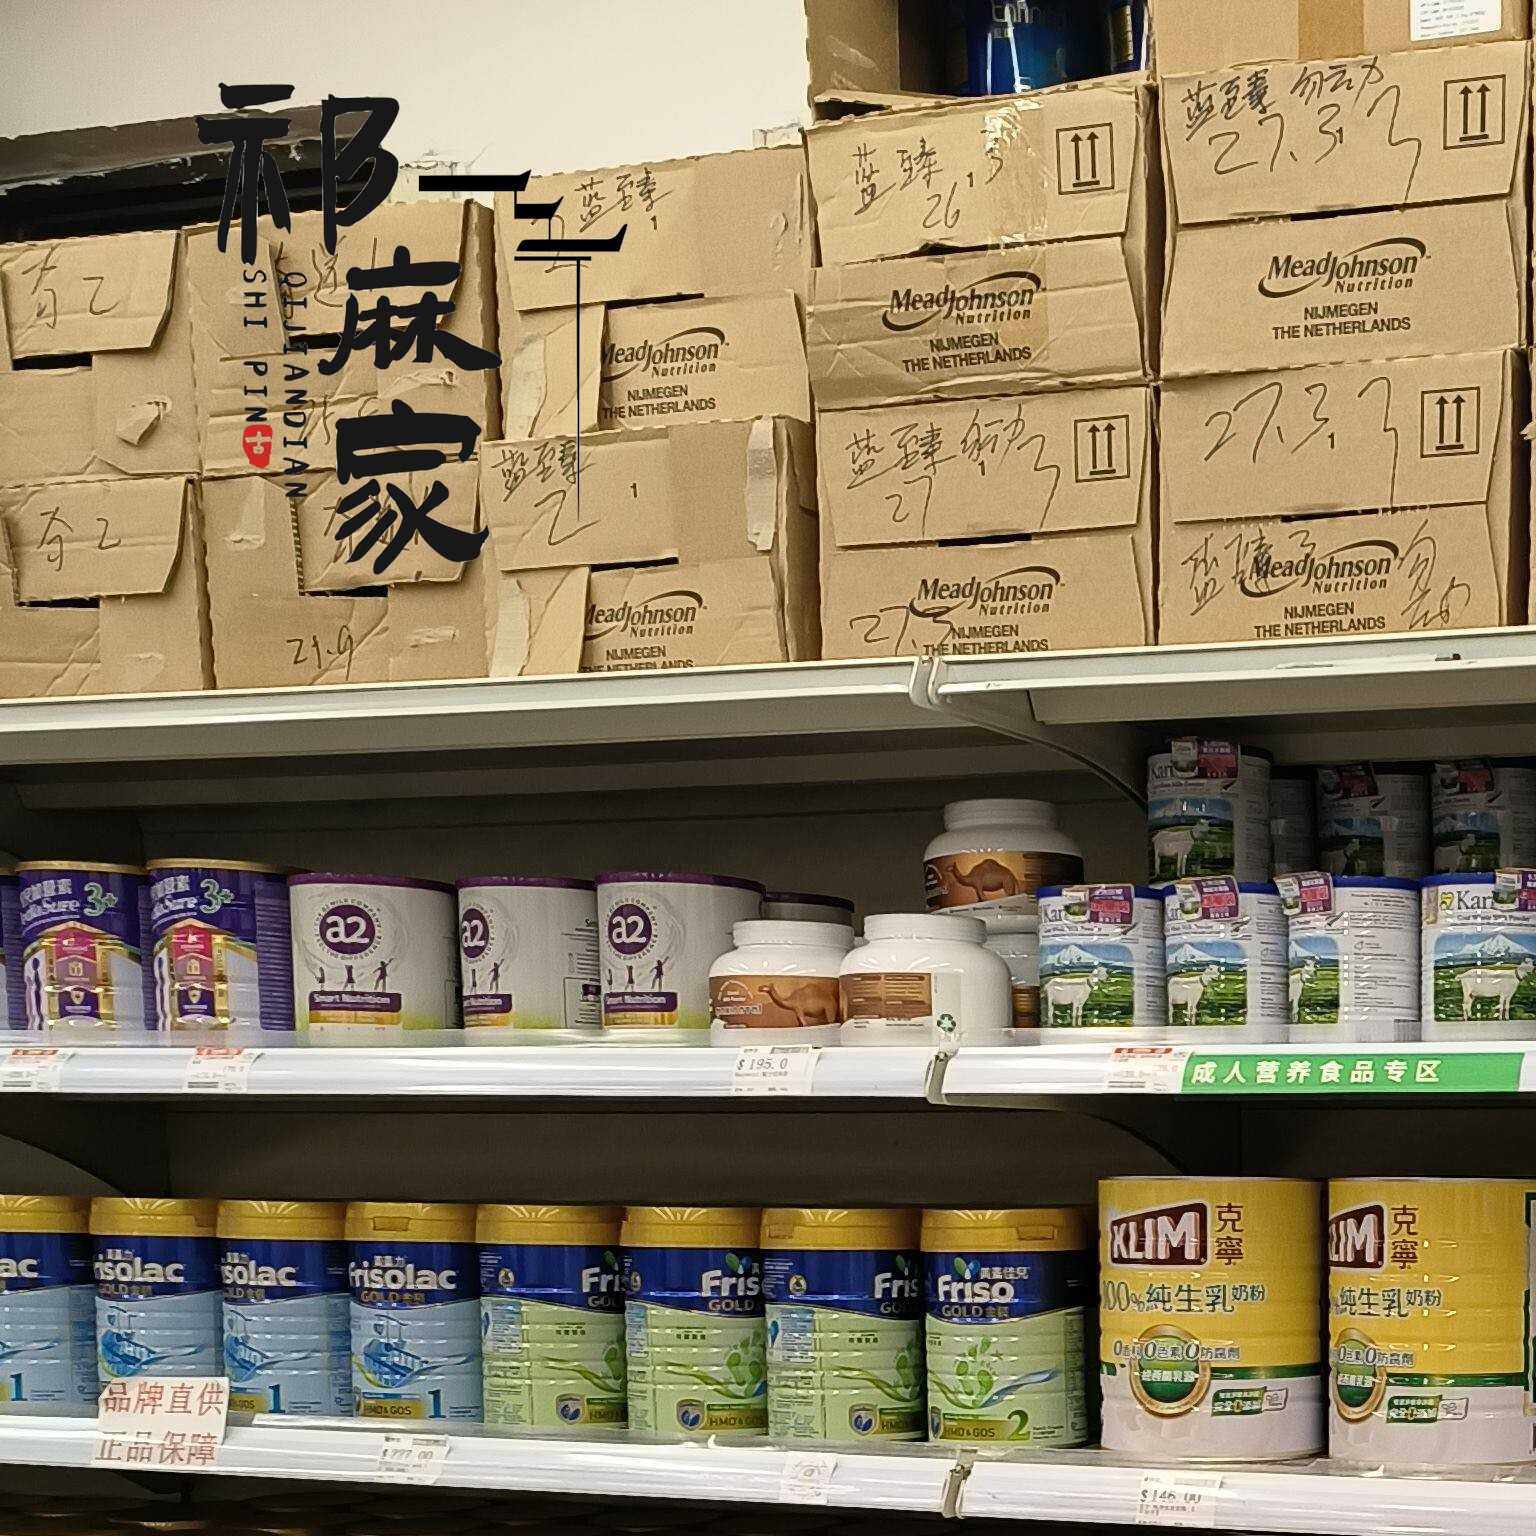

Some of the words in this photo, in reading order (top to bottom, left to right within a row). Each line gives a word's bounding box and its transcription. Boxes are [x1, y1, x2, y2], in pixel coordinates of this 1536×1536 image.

[1268, 253, 1417, 287] MeadJohnson
[1334, 276, 1413, 292] Nutrition
[890, 286, 1034, 319] MeadJohnson
[1304, 302, 1378, 319] NIJMEGEN
[956, 308, 1030, 326] Nutrition
[1272, 325, 1300, 340] THE
[1304, 316, 1411, 337] NETHERLANDS
[929, 333, 998, 353] NIJMEGEN
[651, 361, 716, 378] Nutrition
[902, 357, 930, 373] THE
[933, 346, 1031, 369] NETHERLANDS
[627, 384, 688, 402] NIJMEGEN
[602, 405, 627, 419] THE
[628, 398, 717, 417] NETHERLANDS
[1313, 576, 1386, 593] Nutrition
[1255, 623, 1282, 638] THE
[606, 646, 666, 661] NIJMEGEN
[923, 642, 950, 656] THE
[325, 915, 370, 945] a2
[461, 919, 485, 947] a2
[612, 915, 647, 944] a2
[1191, 1060, 1442, 1084] 成人营养食品专区
[1112, 1210, 1200, 1261] KLIM
[1215, 1203, 1244, 1266] 克寧
[1391, 1204, 1419, 1270] 克寧
[937, 1272, 1016, 1303] Friso
[105, 1380, 223, 1417] 品牌直供
[268, 1383, 286, 1414] 1
[428, 1390, 447, 1419] 1
[1008, 1410, 1030, 1442] 2
[97, 1430, 217, 1466] 正品保障
